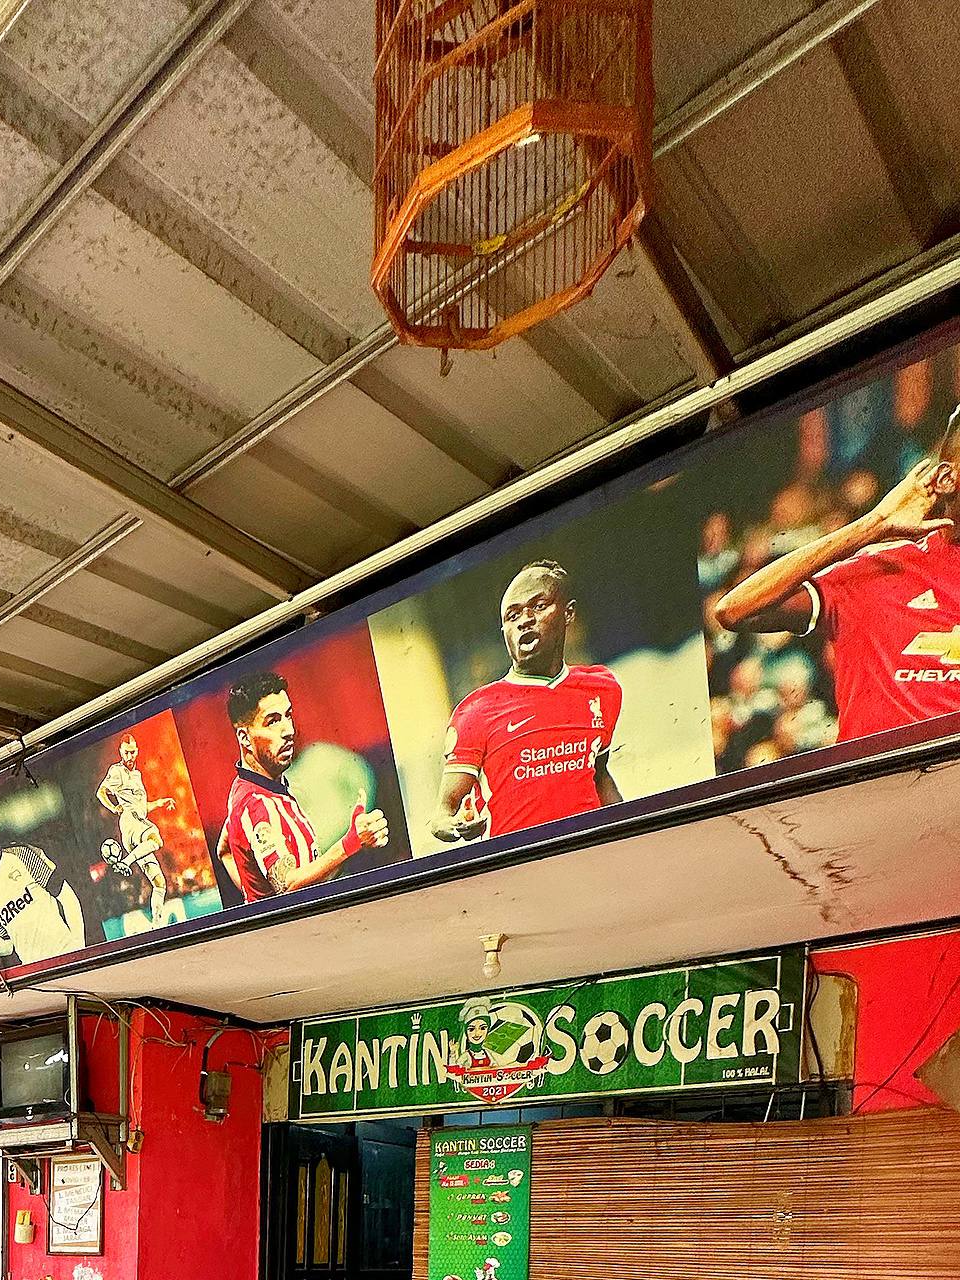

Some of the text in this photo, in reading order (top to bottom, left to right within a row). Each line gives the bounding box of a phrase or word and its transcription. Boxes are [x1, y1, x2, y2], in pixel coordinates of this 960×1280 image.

[520, 737, 587, 763] Standard
[513, 755, 586, 780] Chartered
[301, 988, 781, 1096] KANTIN SOCCER
[722, 1069, 736, 1079] 100
[744, 1066, 770, 1077] HALAL
[482, 1086, 507, 1096] 2021
[434, 1139, 476, 1153] KANTIN
[480, 1135, 527, 1150] SOCCER
